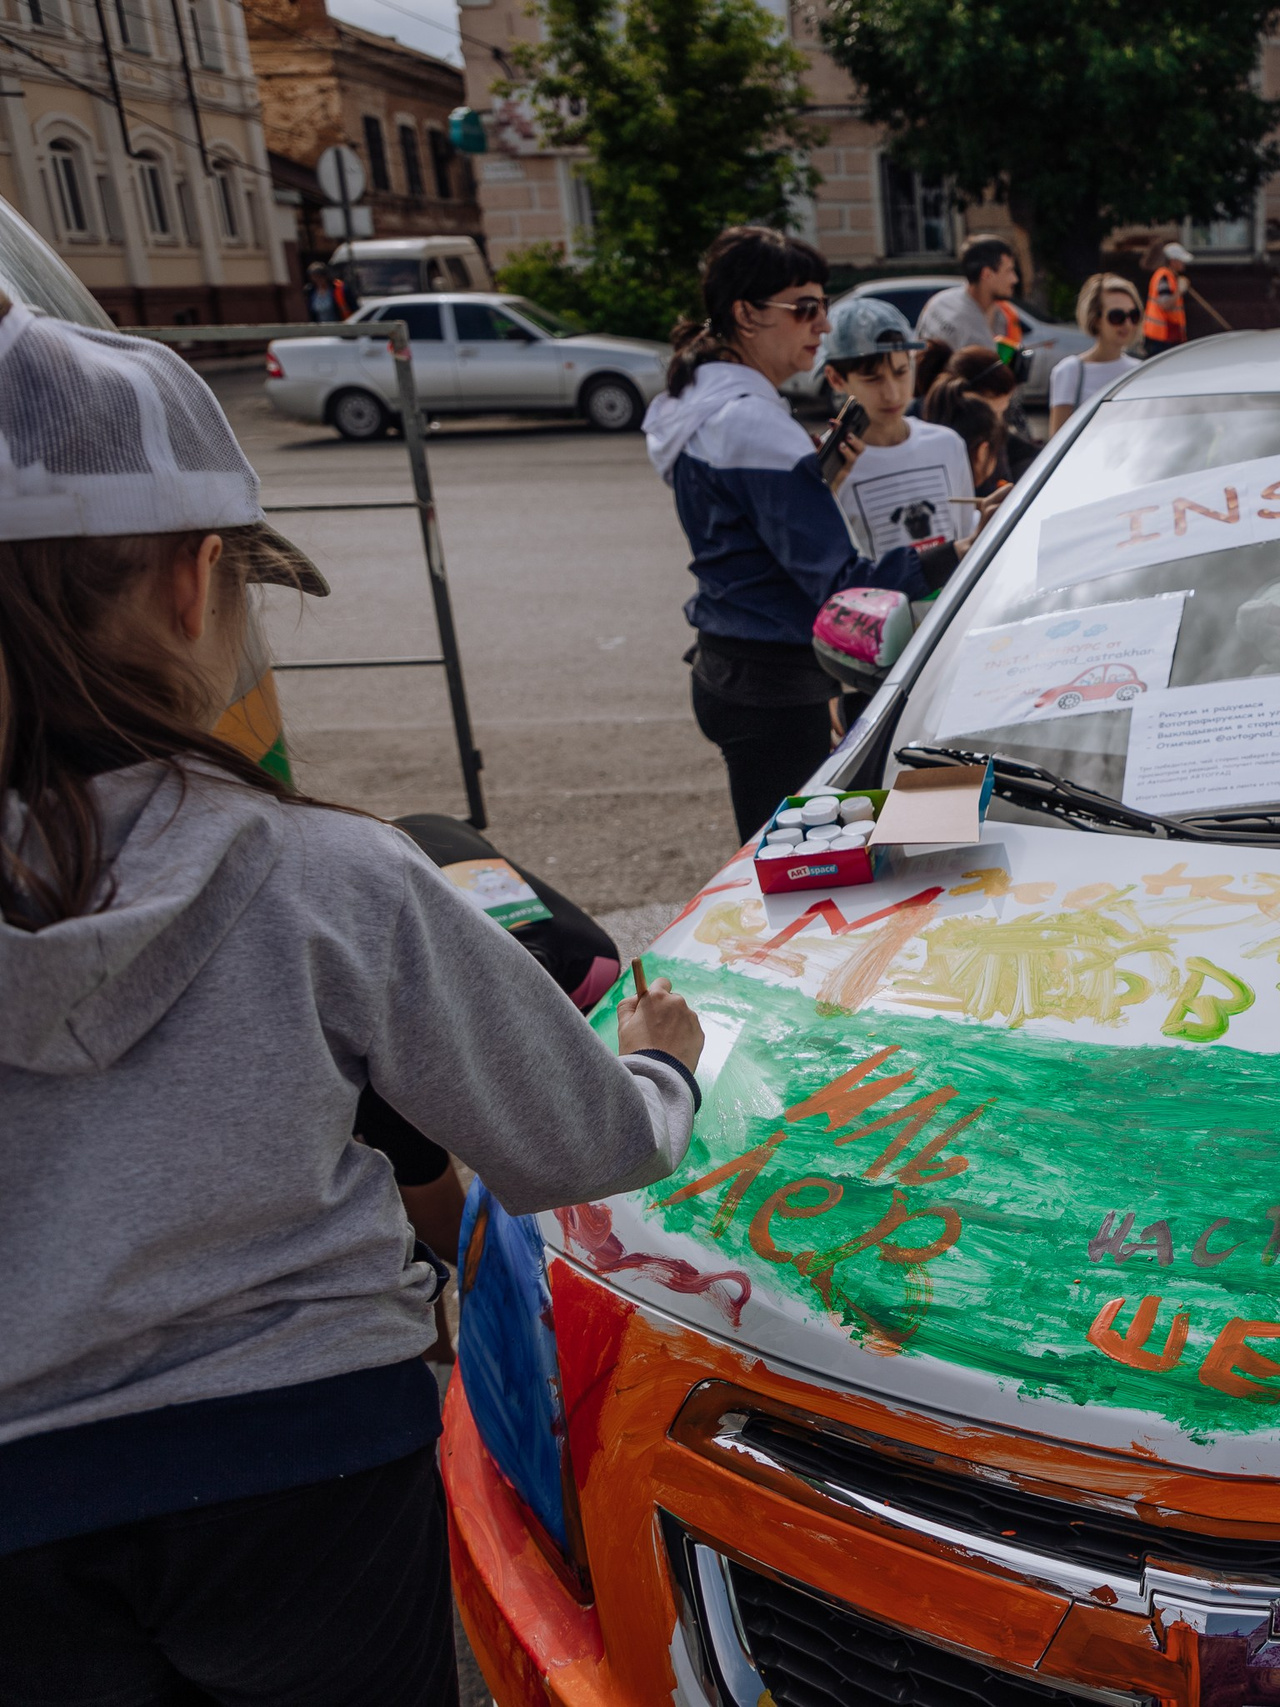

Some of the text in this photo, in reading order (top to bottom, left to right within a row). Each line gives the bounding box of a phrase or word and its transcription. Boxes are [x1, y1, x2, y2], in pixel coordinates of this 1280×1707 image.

[1158, 708, 1198, 719] Рисуем
[1213, 701, 1264, 714] радуемся
[1157, 724, 1233, 740] Выкладываем
[1156, 737, 1211, 750] Отмечаем
